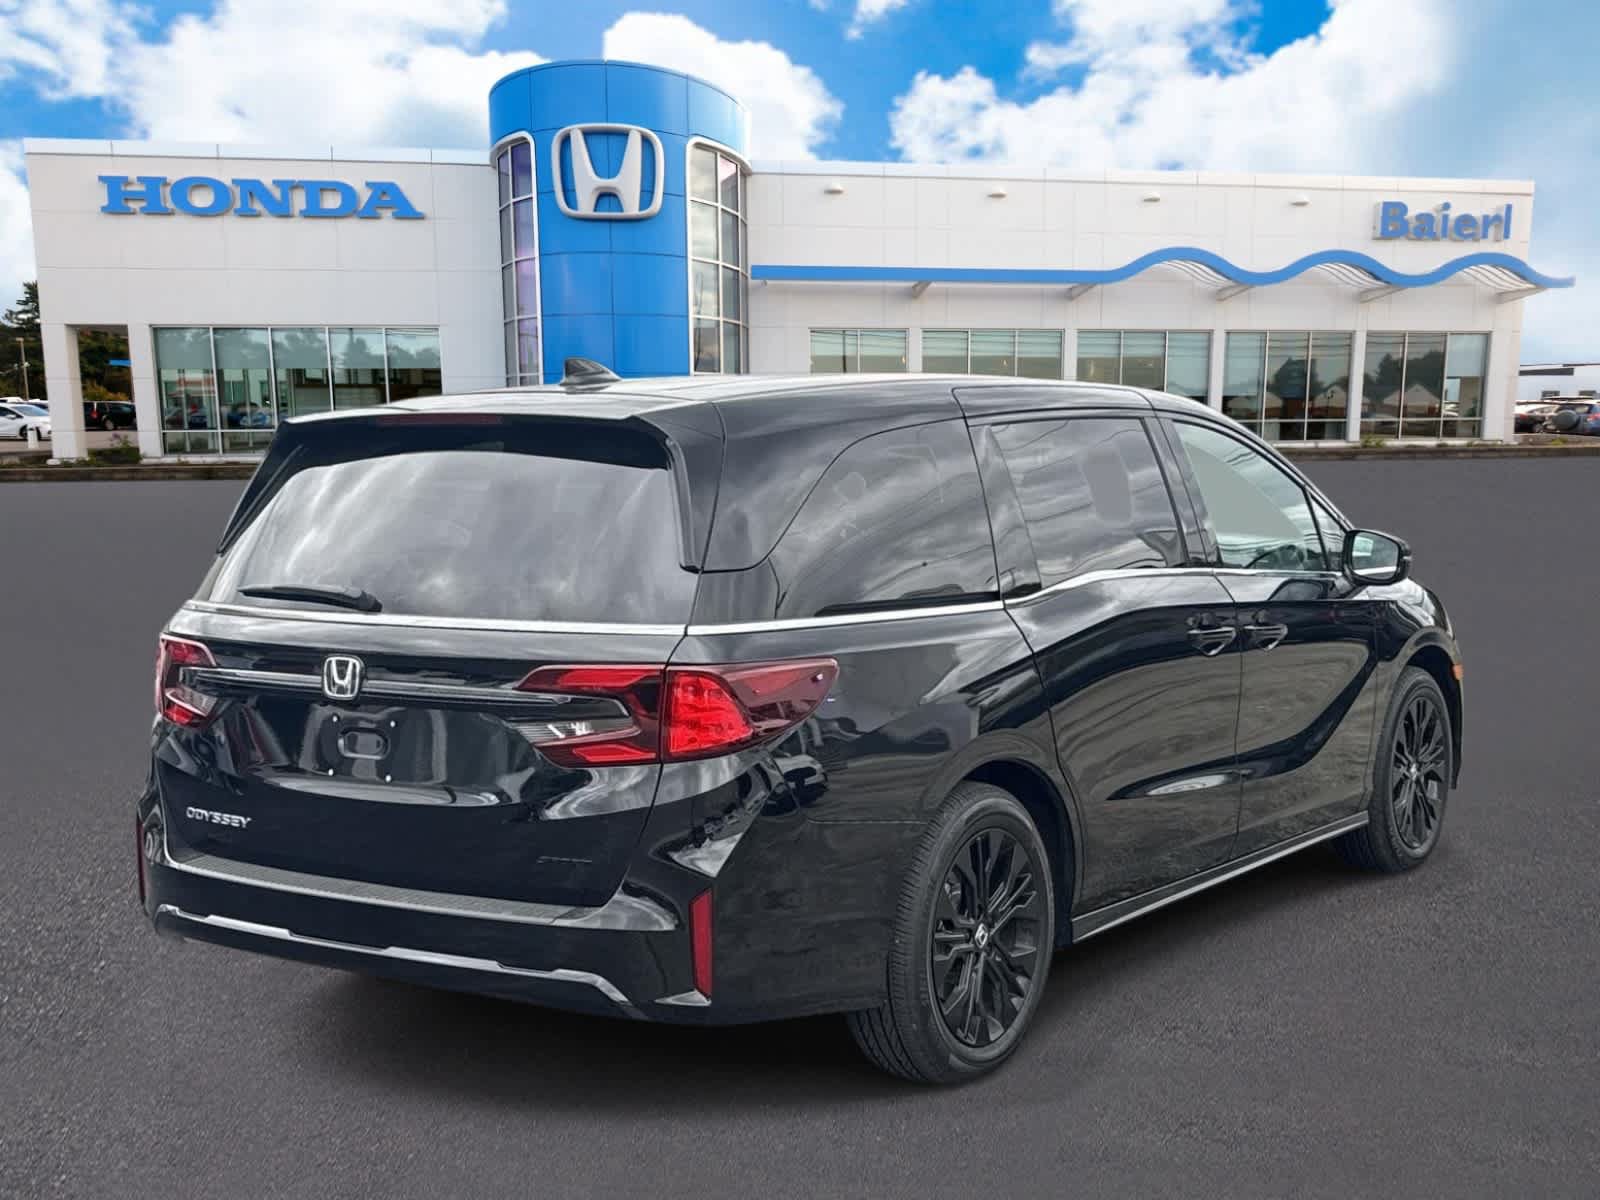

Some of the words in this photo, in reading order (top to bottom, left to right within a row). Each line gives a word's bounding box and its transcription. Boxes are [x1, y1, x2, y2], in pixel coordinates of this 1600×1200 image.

[98, 175, 424, 219] HONDA
[1378, 201, 1513, 240] Baierl
[186, 806, 252, 828] ODYSSEY
